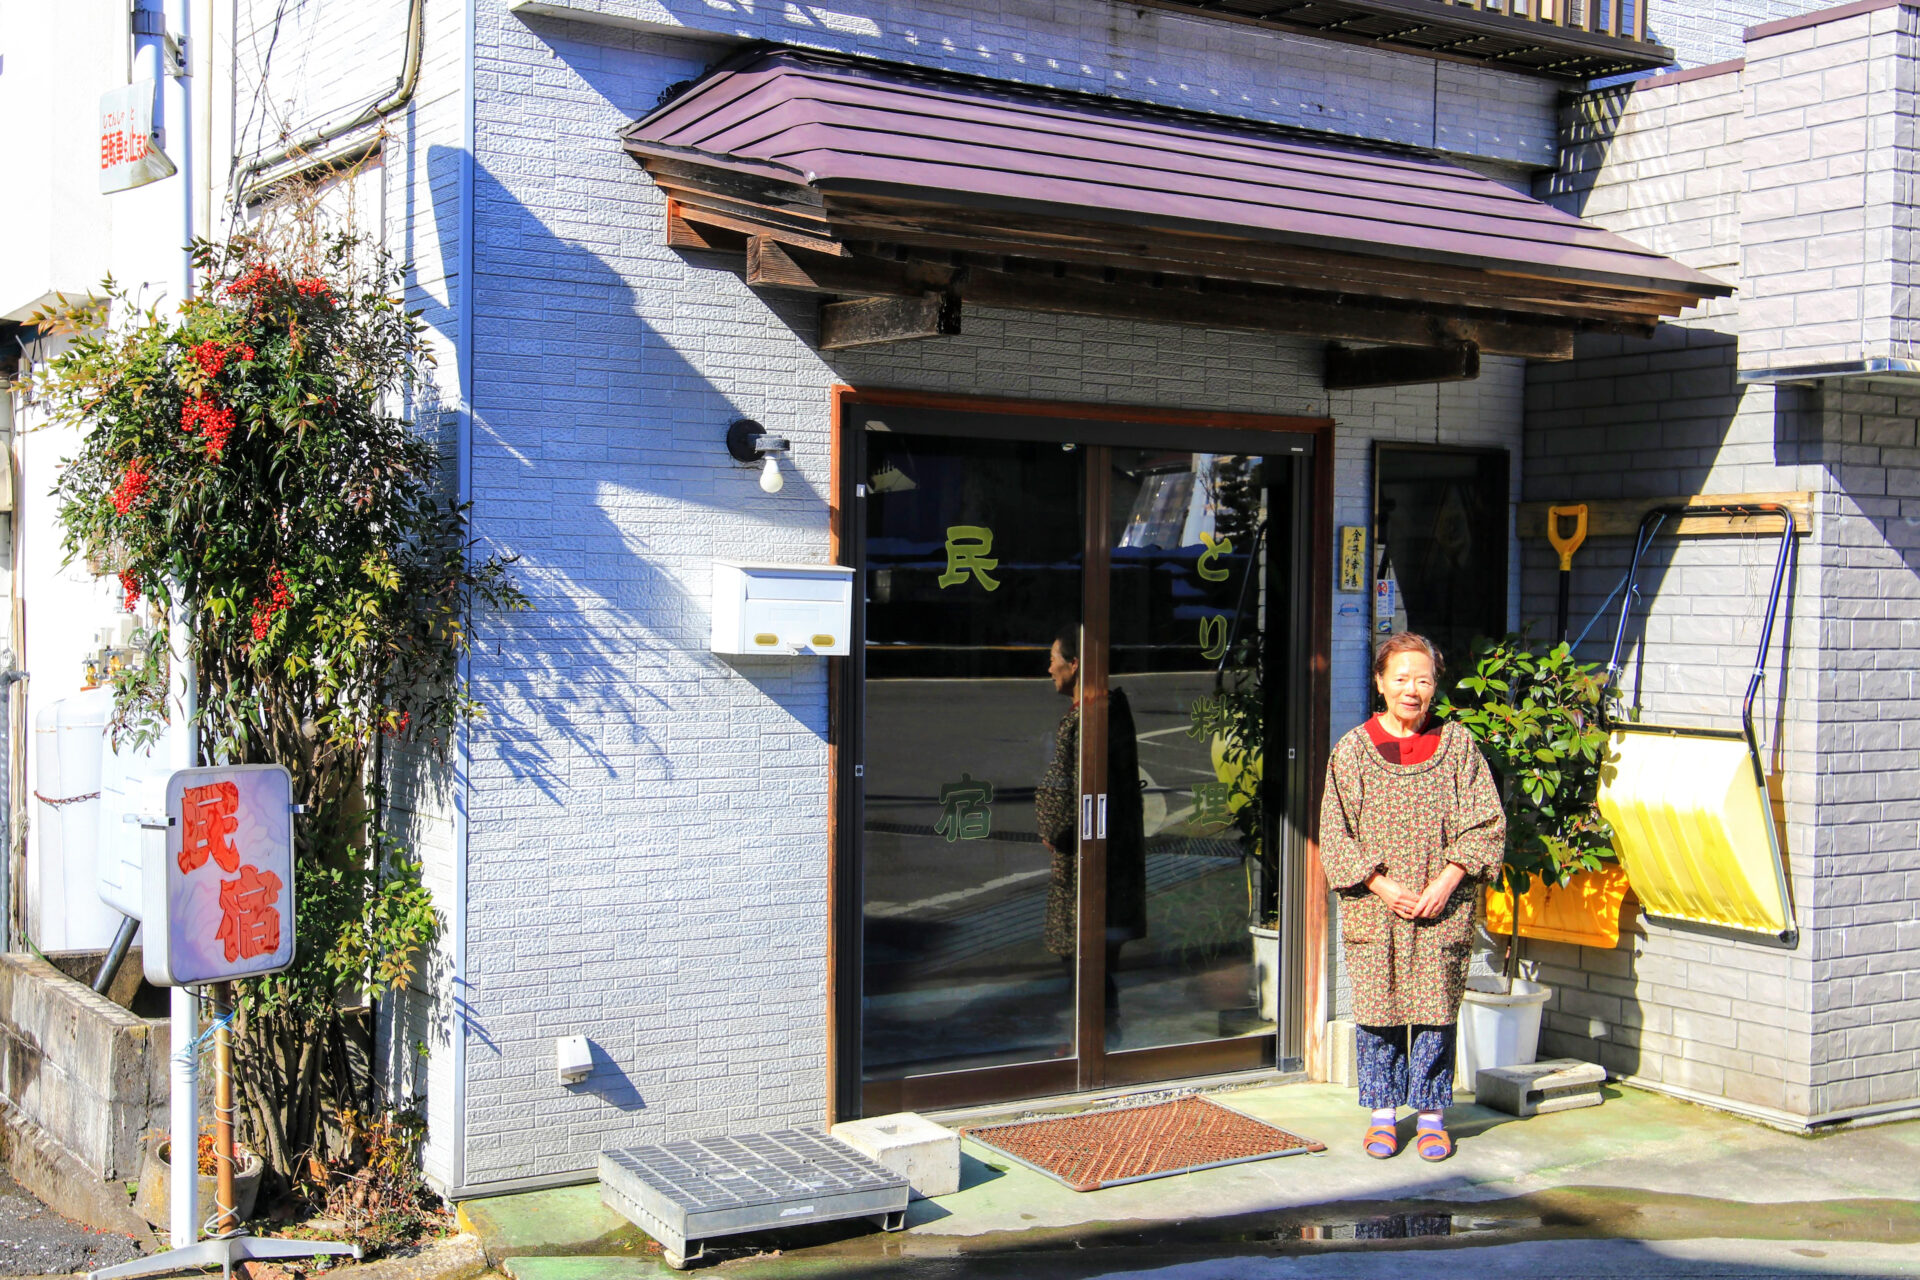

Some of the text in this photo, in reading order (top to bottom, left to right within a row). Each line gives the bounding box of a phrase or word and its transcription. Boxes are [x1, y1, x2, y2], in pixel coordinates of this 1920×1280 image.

[934, 525, 1000, 842] 民宿
[1186, 531, 1235, 826] とり料理
[177, 780, 283, 963] 民宿
